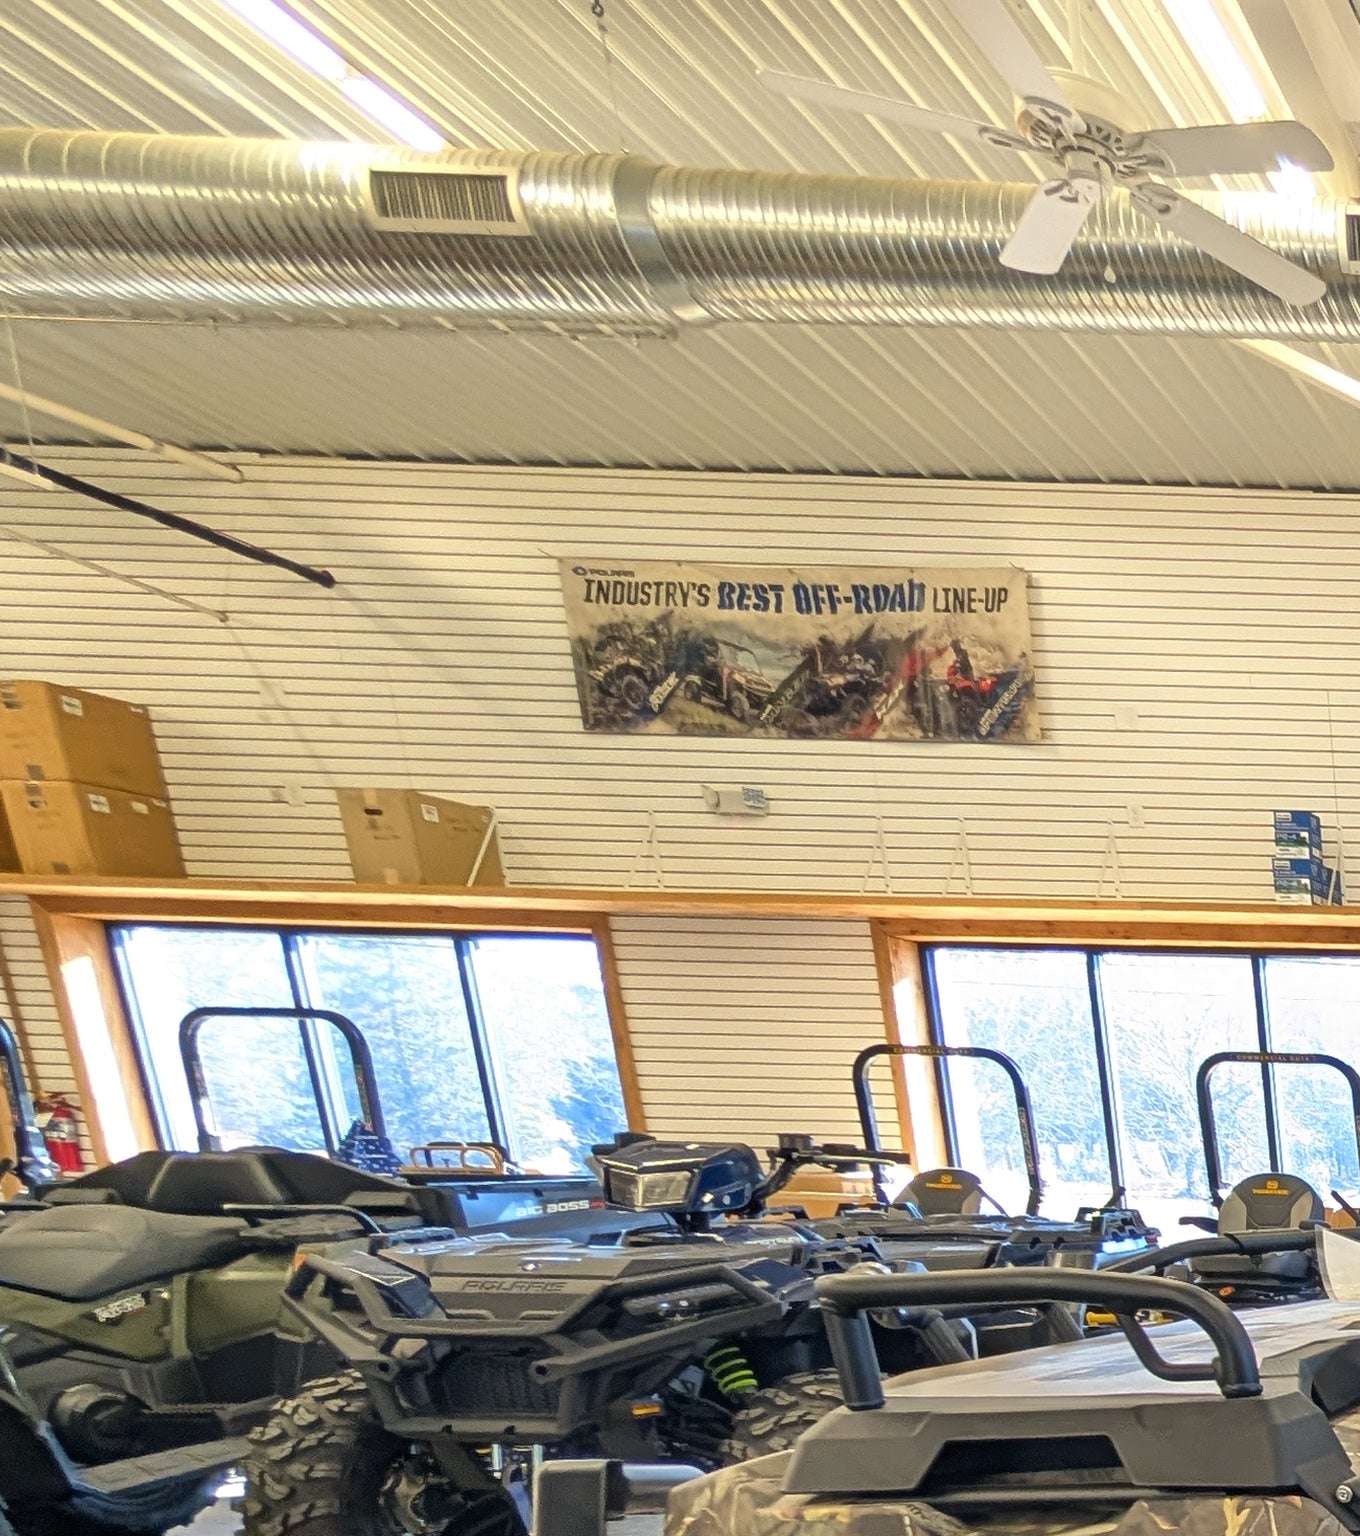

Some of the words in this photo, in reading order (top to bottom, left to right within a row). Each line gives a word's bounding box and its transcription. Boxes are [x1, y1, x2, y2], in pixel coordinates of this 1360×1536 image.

[583, 579, 711, 607] INDUSTRY'S
[717, 581, 785, 614] BEST
[793, 578, 927, 615] OFF-ROAD
[933, 587, 1008, 613] LINE-UP
[516, 1206, 543, 1217] BIG
[547, 1200, 590, 1213] BOSS
